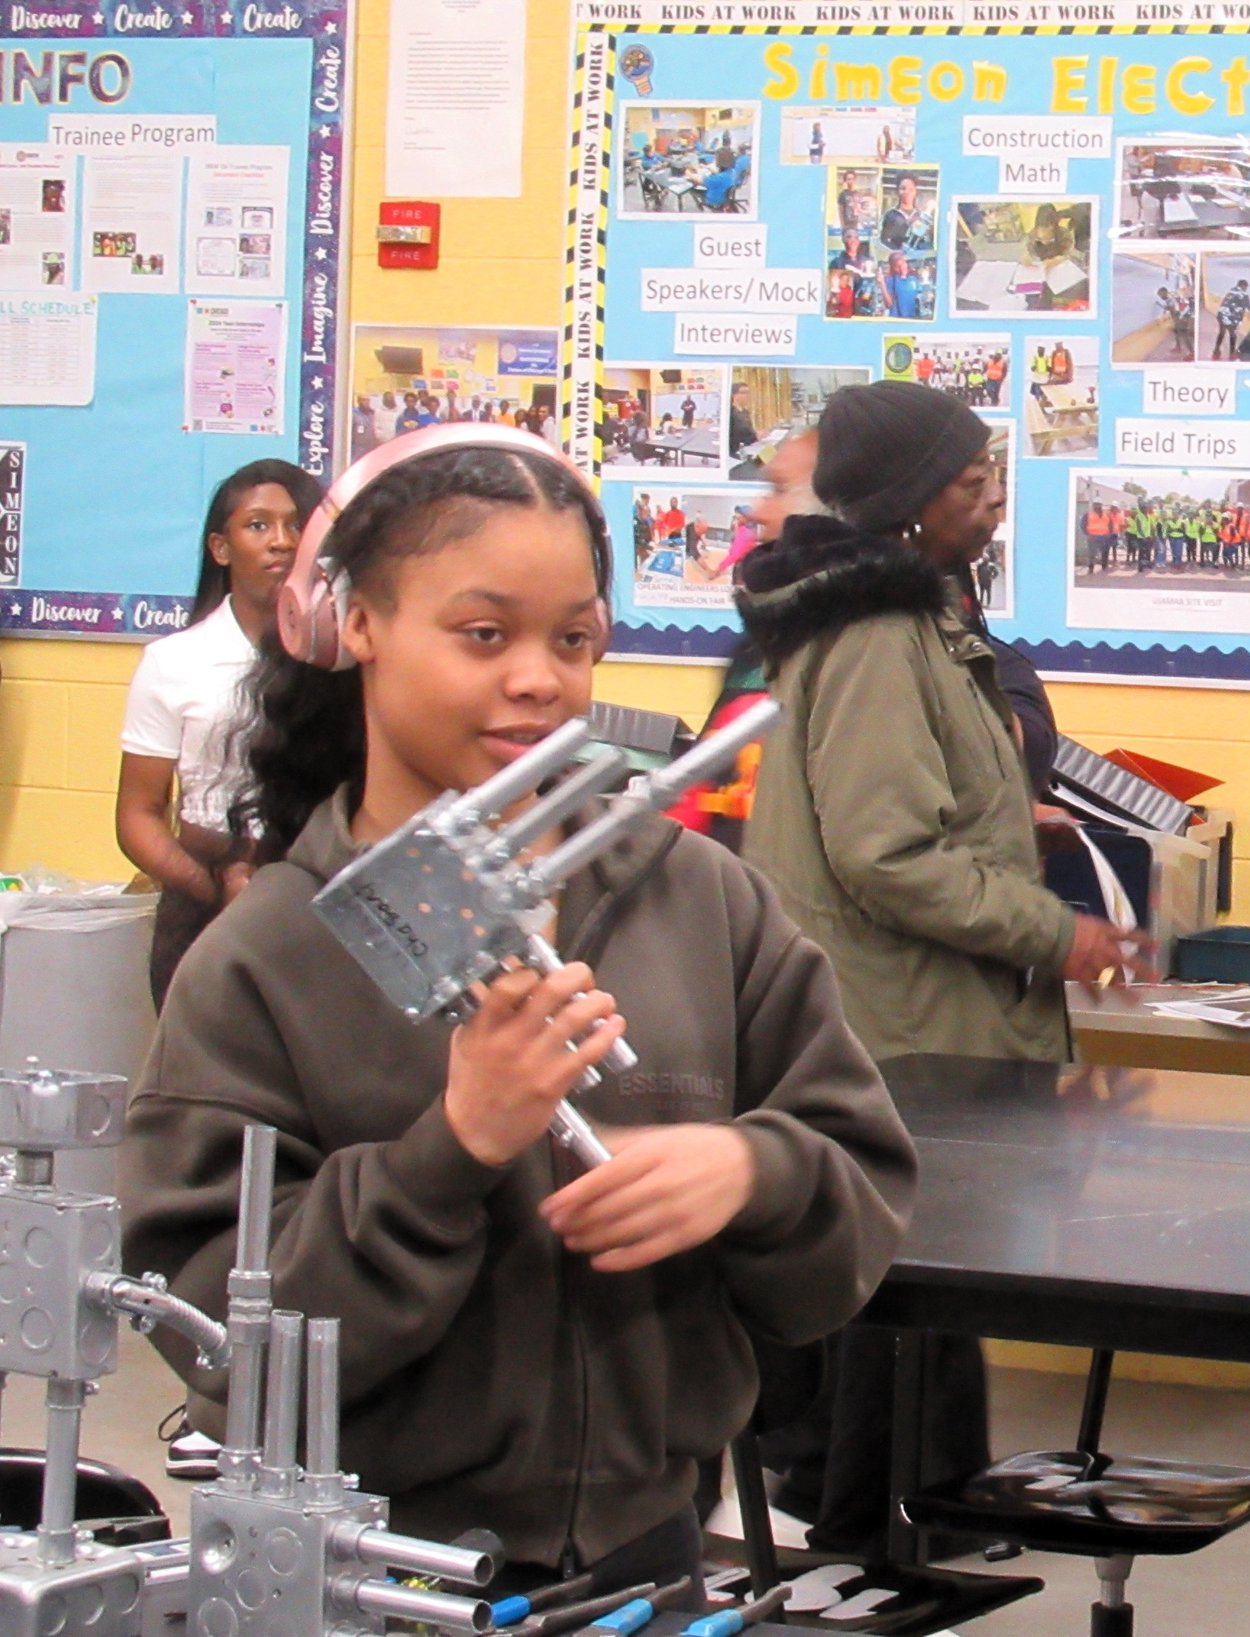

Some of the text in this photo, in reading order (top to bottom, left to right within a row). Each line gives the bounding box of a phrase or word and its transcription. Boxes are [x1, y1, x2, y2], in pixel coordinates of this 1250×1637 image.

[11, 5, 82, 31] Discover
[114, 4, 173, 32] Create
[242, 4, 302, 32] Create
[589, 3, 642, 19] WORK
[661, 4, 797, 21] KIDS AT WORK
[816, 5, 955, 20] KIDS AT WORK
[973, 4, 1116, 20] KIDS AT WORK
[1136, 4, 1182, 20] KIDS
[1188, 4, 1216, 20] AT
[313, 45, 342, 114] Create
[582, 42, 604, 191] KIDS AT WORK
[52, 123, 215, 148] Trainee Program
[967, 128, 1104, 149] Construction
[1004, 162, 1062, 183] Math
[309, 151, 336, 236] Discover
[392, 209, 422, 220] FIRE
[390, 250, 421, 261] FIRE
[699, 235, 762, 258] Guest
[577, 211, 594, 360] KIDS AT WORK
[21, 300, 94, 316] SCHEDULE
[303, 273, 335, 364] Imagine
[680, 322, 793, 345] Interviews
[1148, 380, 1229, 408] Theory
[575, 380, 590, 440] WORK
[302, 399, 330, 477] Explore
[1121, 431, 1237, 458] Field Trips
[31, 595, 101, 625] Discover
[133, 600, 190, 629] Create
